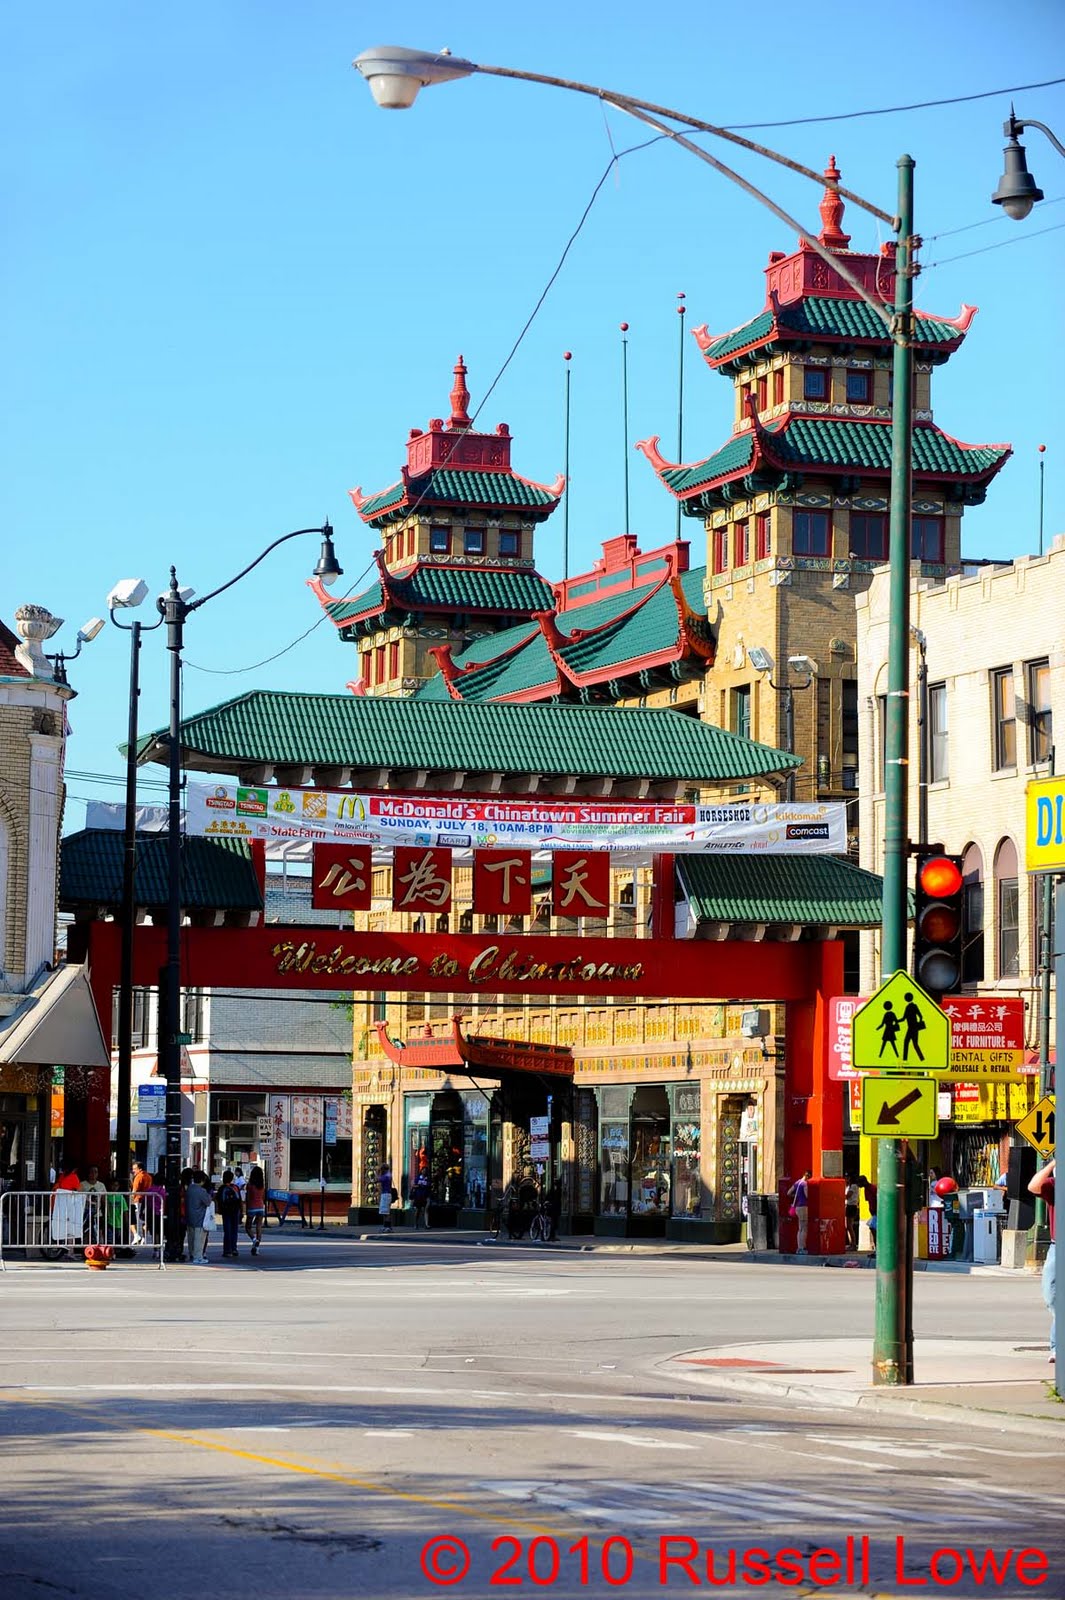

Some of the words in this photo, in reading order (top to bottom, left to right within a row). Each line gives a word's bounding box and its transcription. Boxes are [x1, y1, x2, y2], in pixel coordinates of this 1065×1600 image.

[484, 806, 575, 822] Chinatown
[580, 809, 650, 823] Summer
[655, 809, 685, 823] Fair
[700, 809, 750, 822] HORSESHOE
[1036, 794, 1065, 847] DI
[380, 818, 432, 830] SUNDAY,
[436, 821, 466, 831] JULY
[471, 823, 488, 832] 18,
[493, 823, 553, 833] 10AM-8PM
[790, 827, 828, 836] comcast
[273, 941, 420, 976] Welcome
[427, 952, 459, 977] to
[468, 945, 643, 985] Chinatown
[944, 1004, 1011, 1020] 太平洋
[966, 1035, 1005, 1048] FURNITURE
[989, 1052, 1014, 1062] GIFTS
[950, 1064, 979, 1073] HOLESALE
[982, 1064, 988, 1072] &
[990, 1065, 1010, 1073] RETAIL
